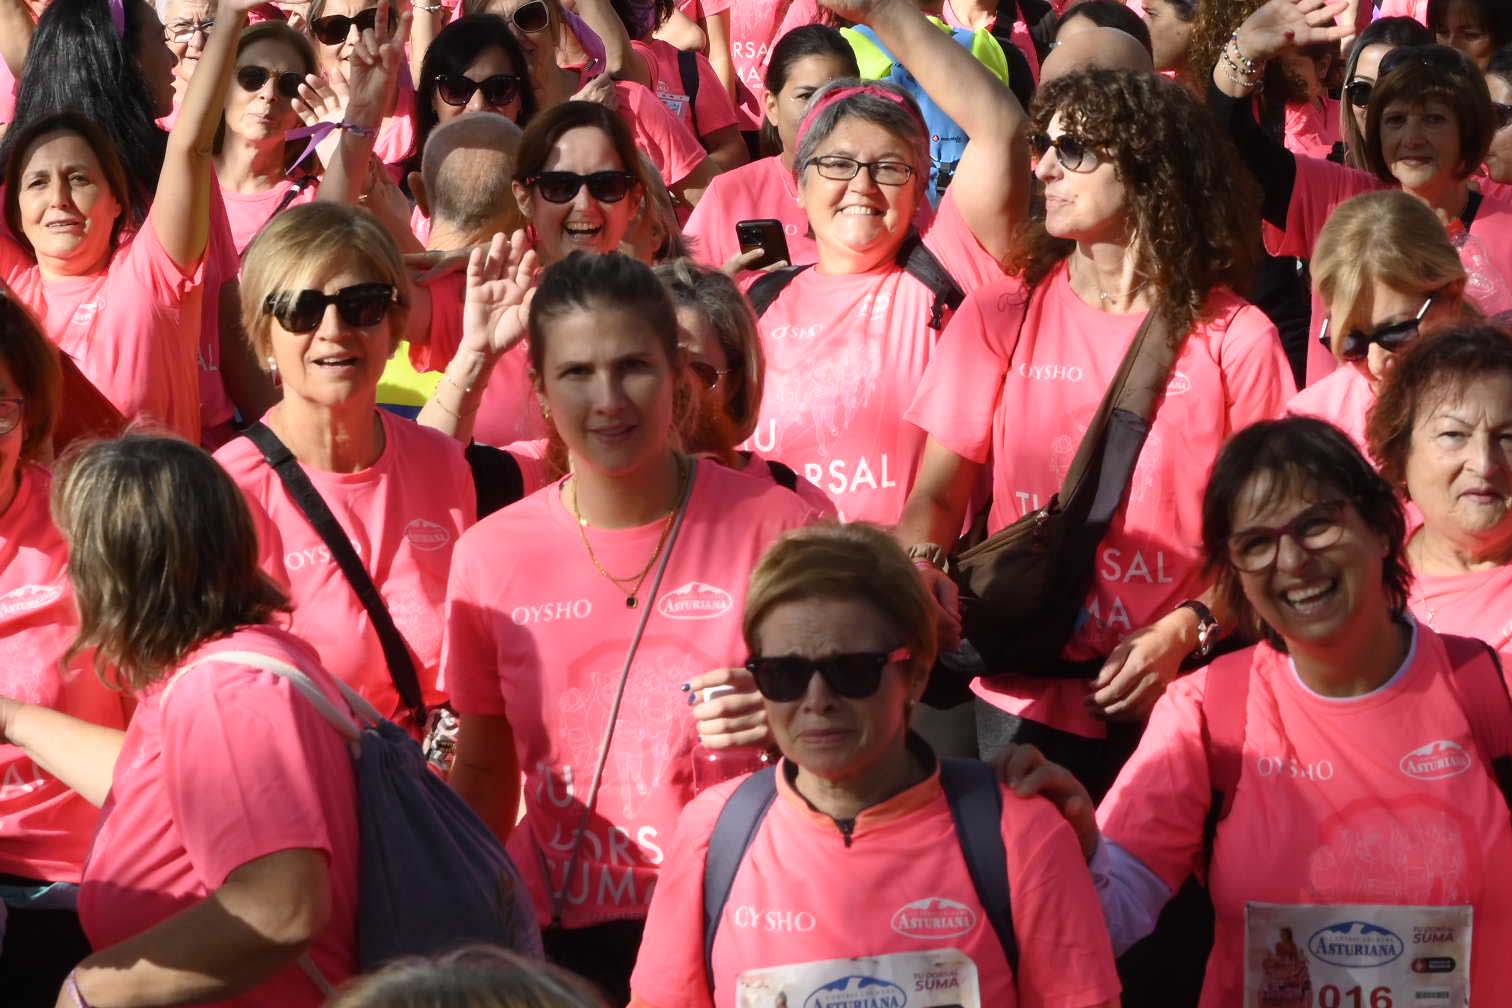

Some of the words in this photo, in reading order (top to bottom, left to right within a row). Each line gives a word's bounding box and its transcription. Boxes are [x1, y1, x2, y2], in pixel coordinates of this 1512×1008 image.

[1019, 362, 1083, 382] OYSHO
[804, 453, 897, 496] RSAL
[1101, 548, 1173, 584] SAL
[511, 598, 593, 626] OYSHO
[665, 593, 727, 613] ASTURIANA
[734, 905, 817, 933] OYSHO
[899, 912, 971, 930] ASTURIANA
[1315, 938, 1397, 958] ASTURIANA
[1413, 932, 1455, 945] SUMA
[914, 977, 960, 992] SUMA
[1318, 984, 1394, 1008] 016
